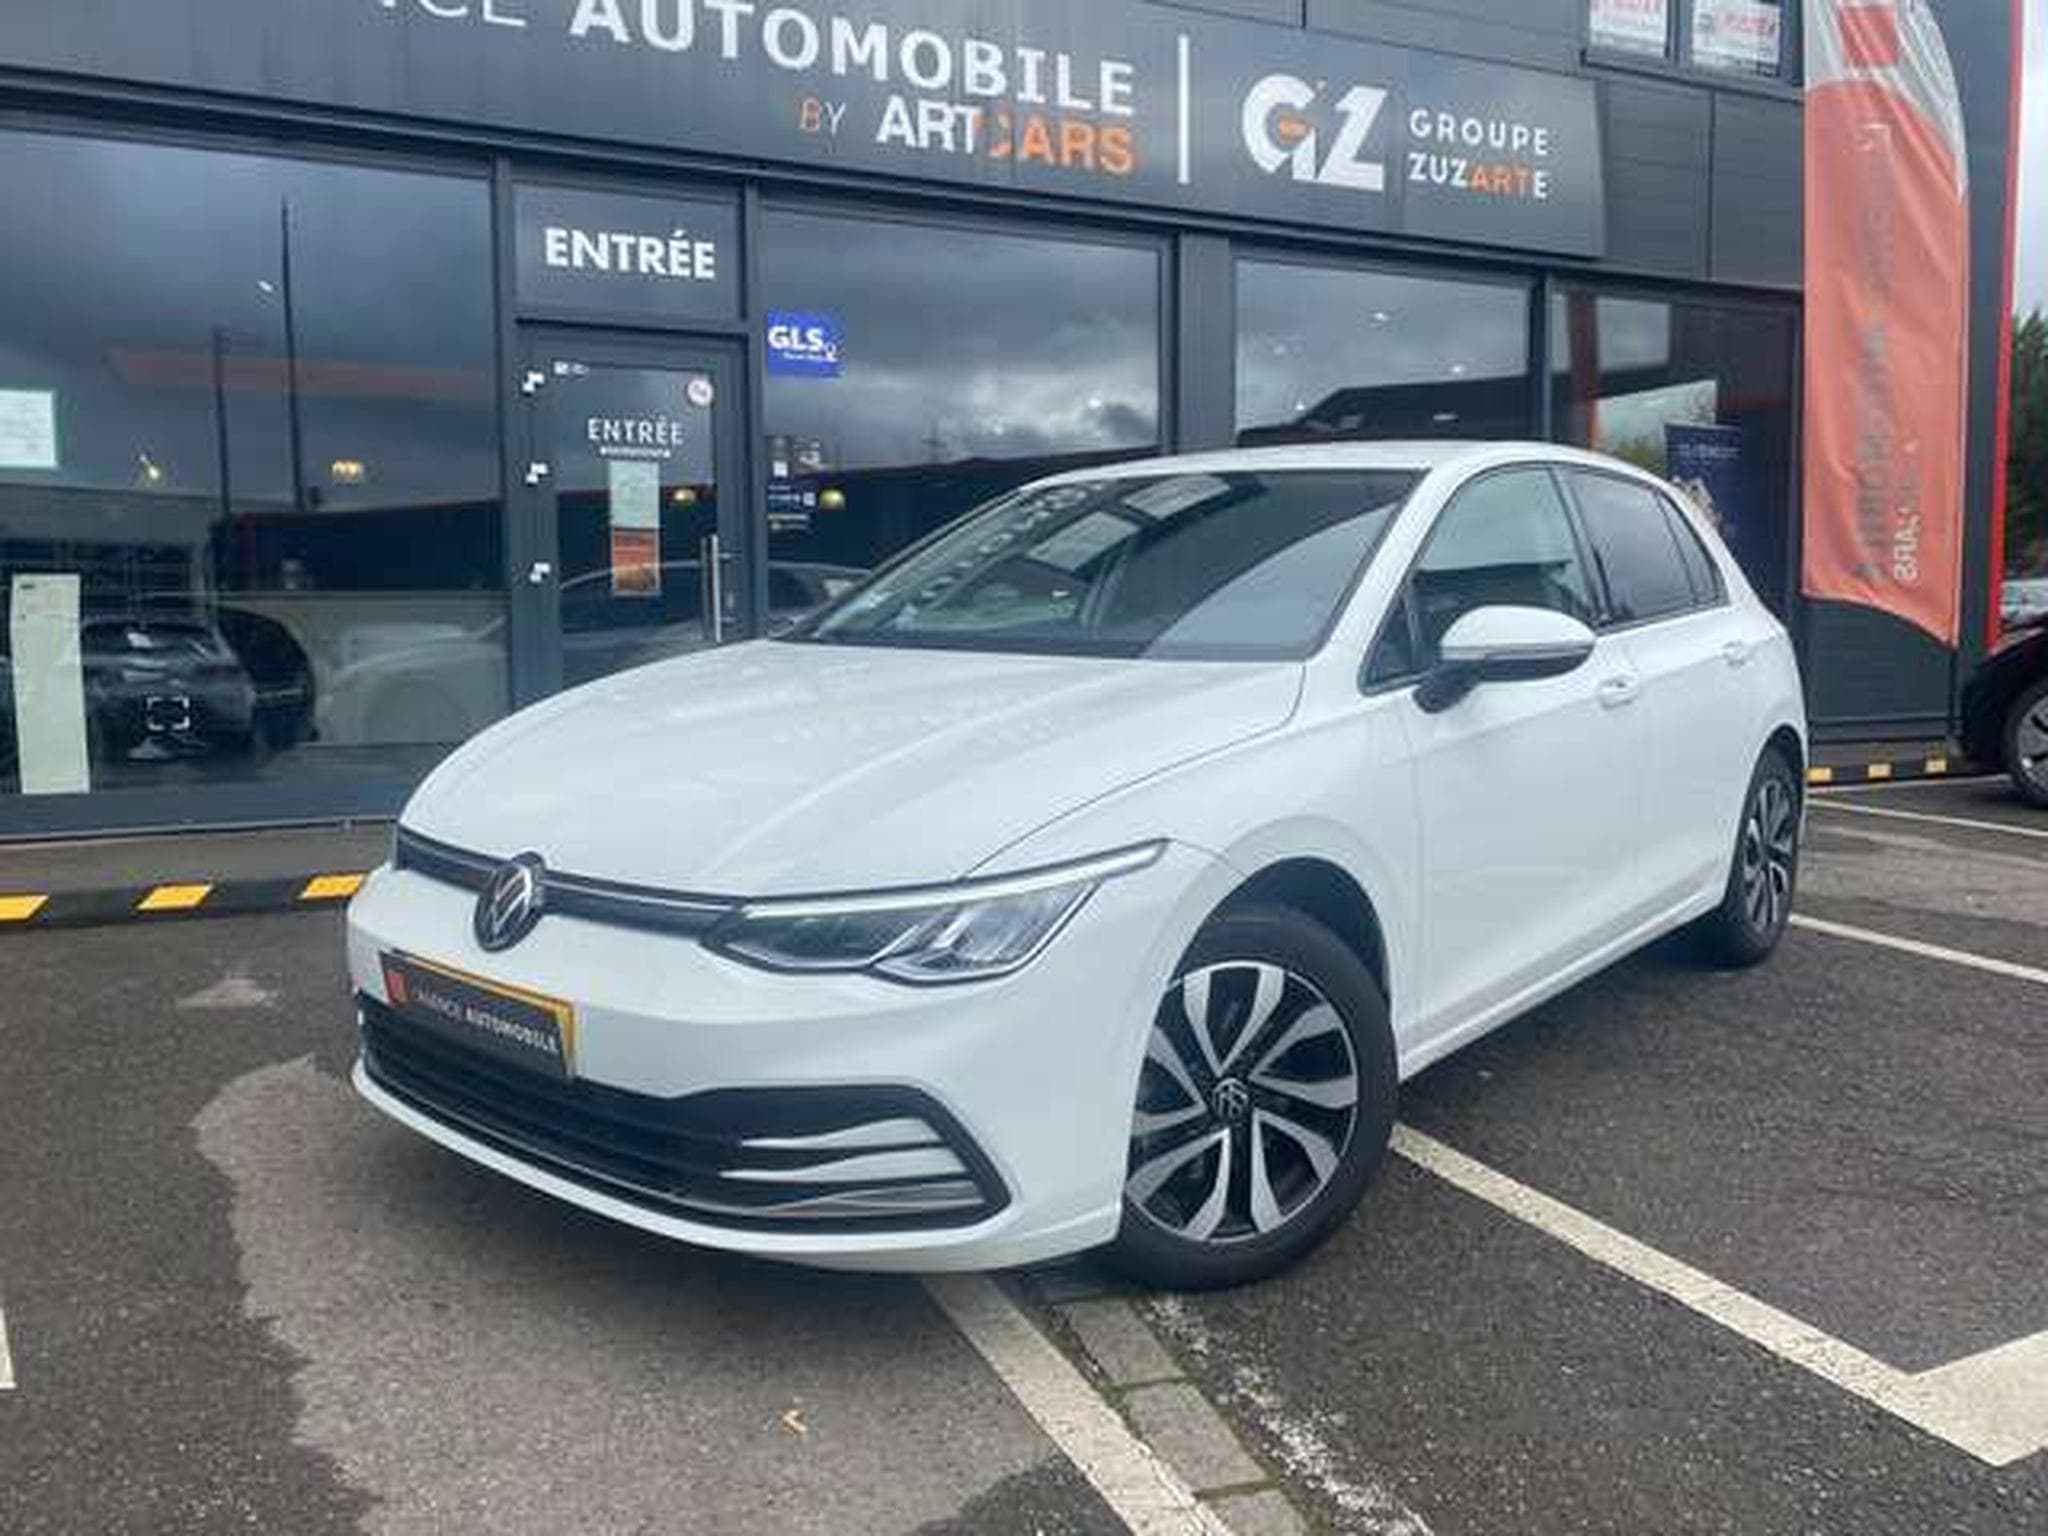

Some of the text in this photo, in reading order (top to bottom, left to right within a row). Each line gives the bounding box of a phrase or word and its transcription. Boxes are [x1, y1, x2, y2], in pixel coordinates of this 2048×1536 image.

[569, 0, 1135, 117] AUTOMOBILE
[800, 97, 847, 136] BY
[1408, 108, 1549, 155] GROUPE
[1408, 151, 1549, 199] ZUZARTE
[544, 227, 716, 280] ENTRÉE
[768, 325, 823, 352] GLS
[587, 414, 684, 446] ENTRÉE
